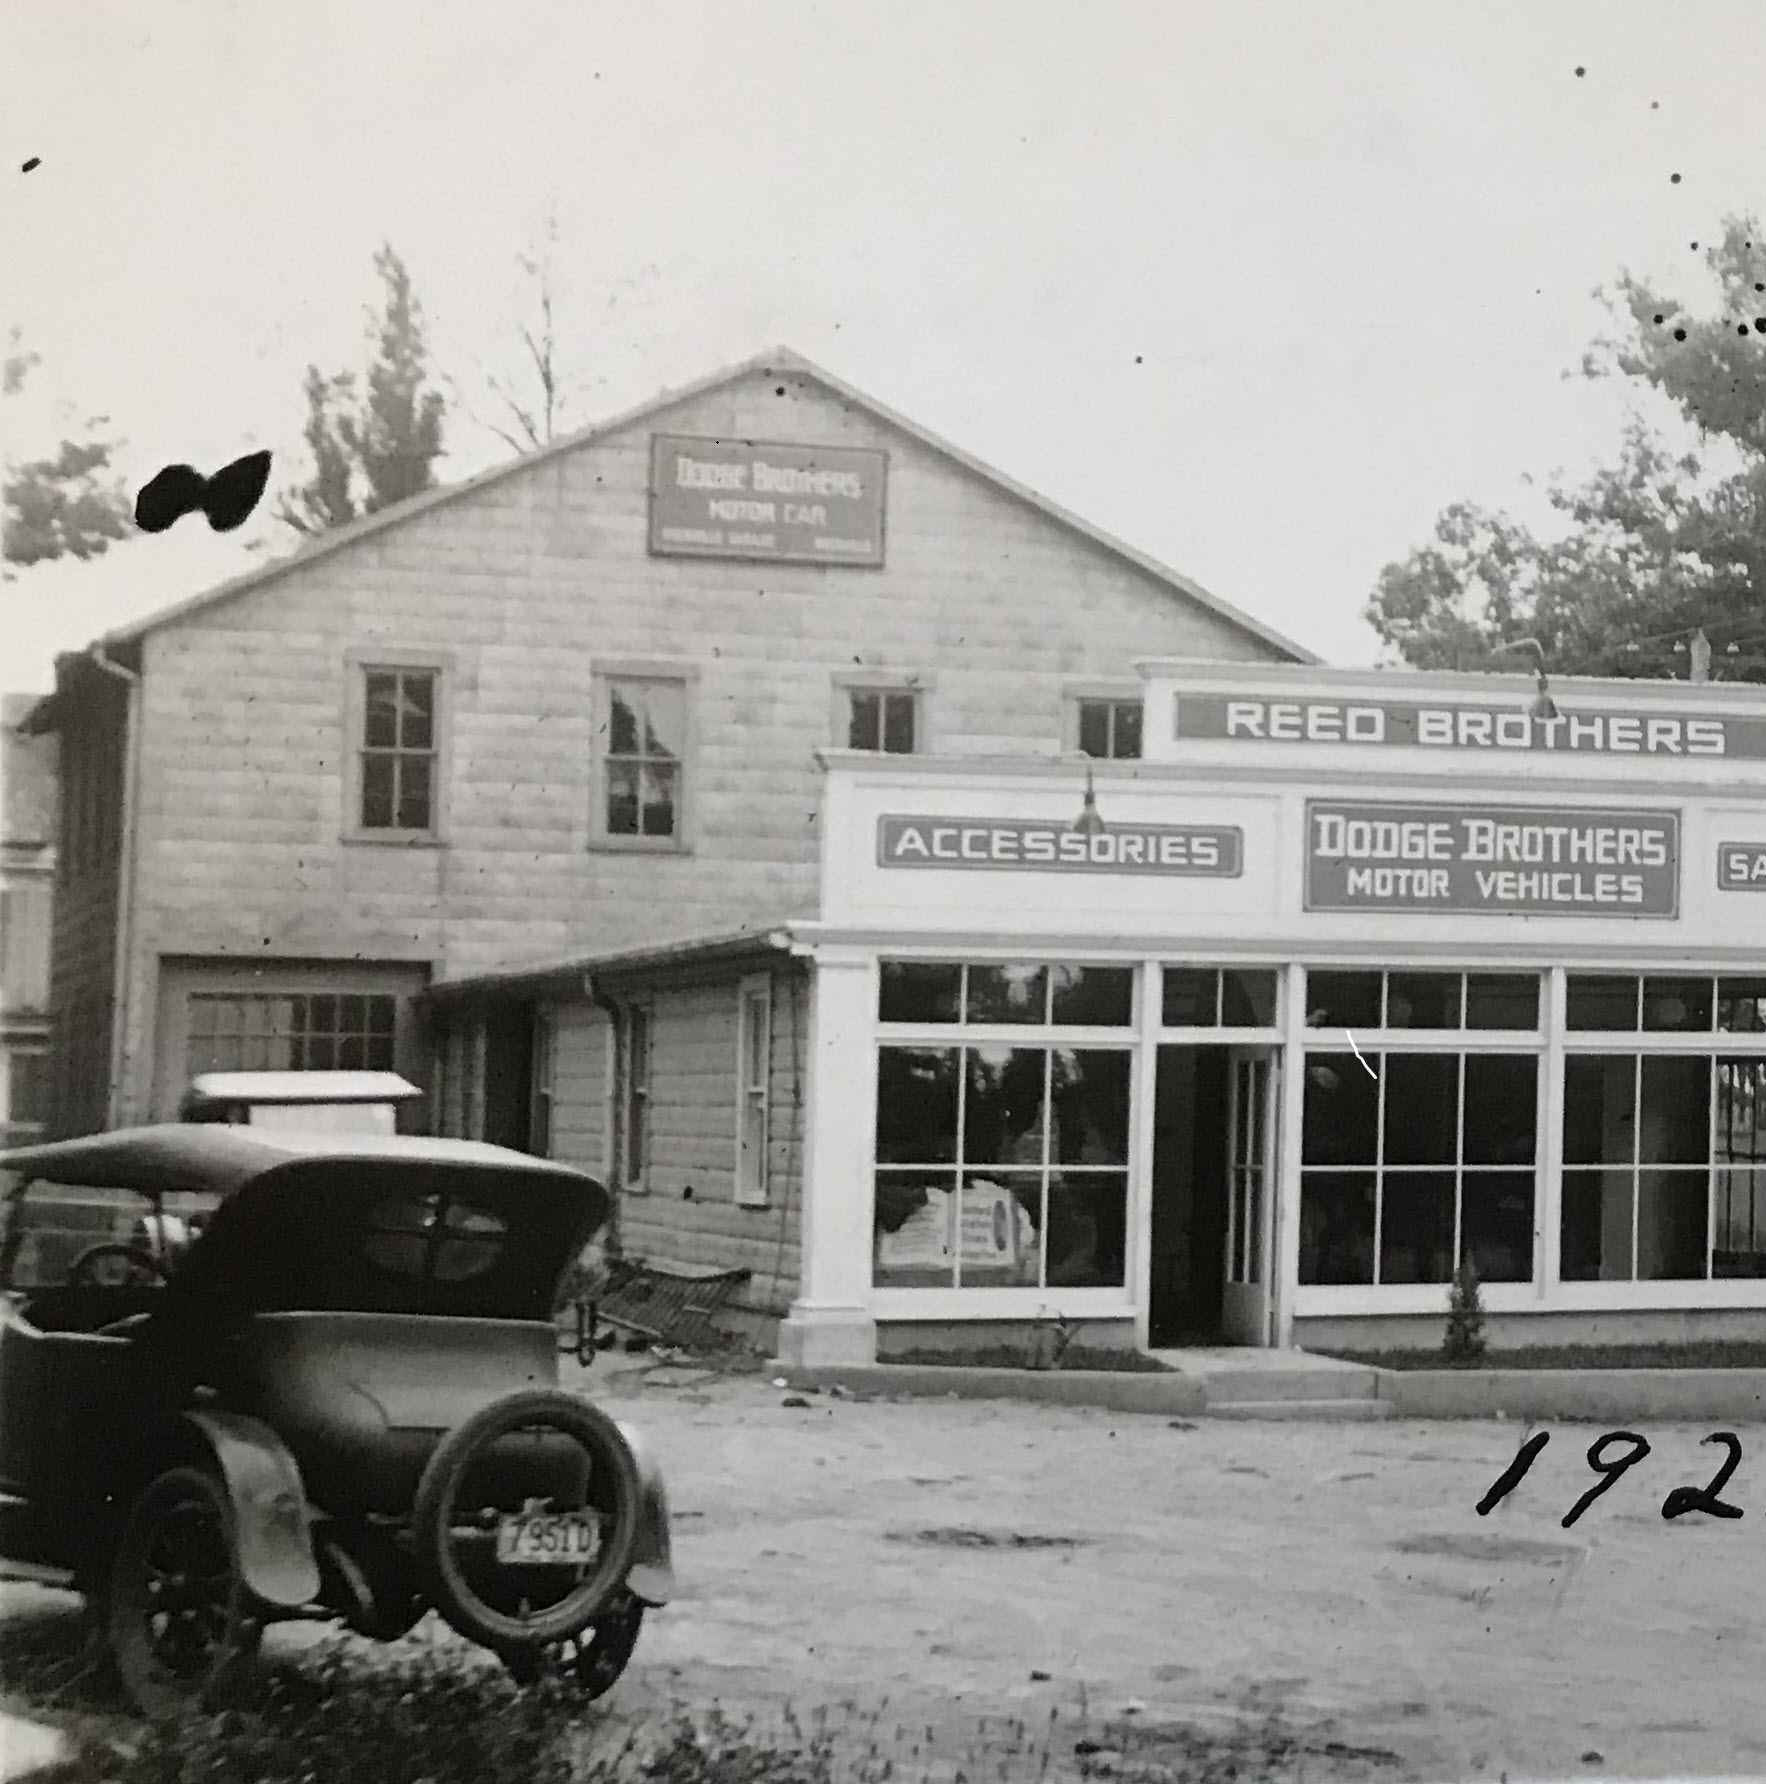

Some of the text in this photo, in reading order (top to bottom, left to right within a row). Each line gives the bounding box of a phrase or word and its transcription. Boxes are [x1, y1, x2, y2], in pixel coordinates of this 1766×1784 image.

[1226, 702, 1726, 754] REED BROTHERS
[894, 826, 1220, 867] ACCESSORIES
[1313, 813, 1666, 866] DODGE BROTHERS
[1346, 867, 1643, 903] MOTOR VEHICLES
